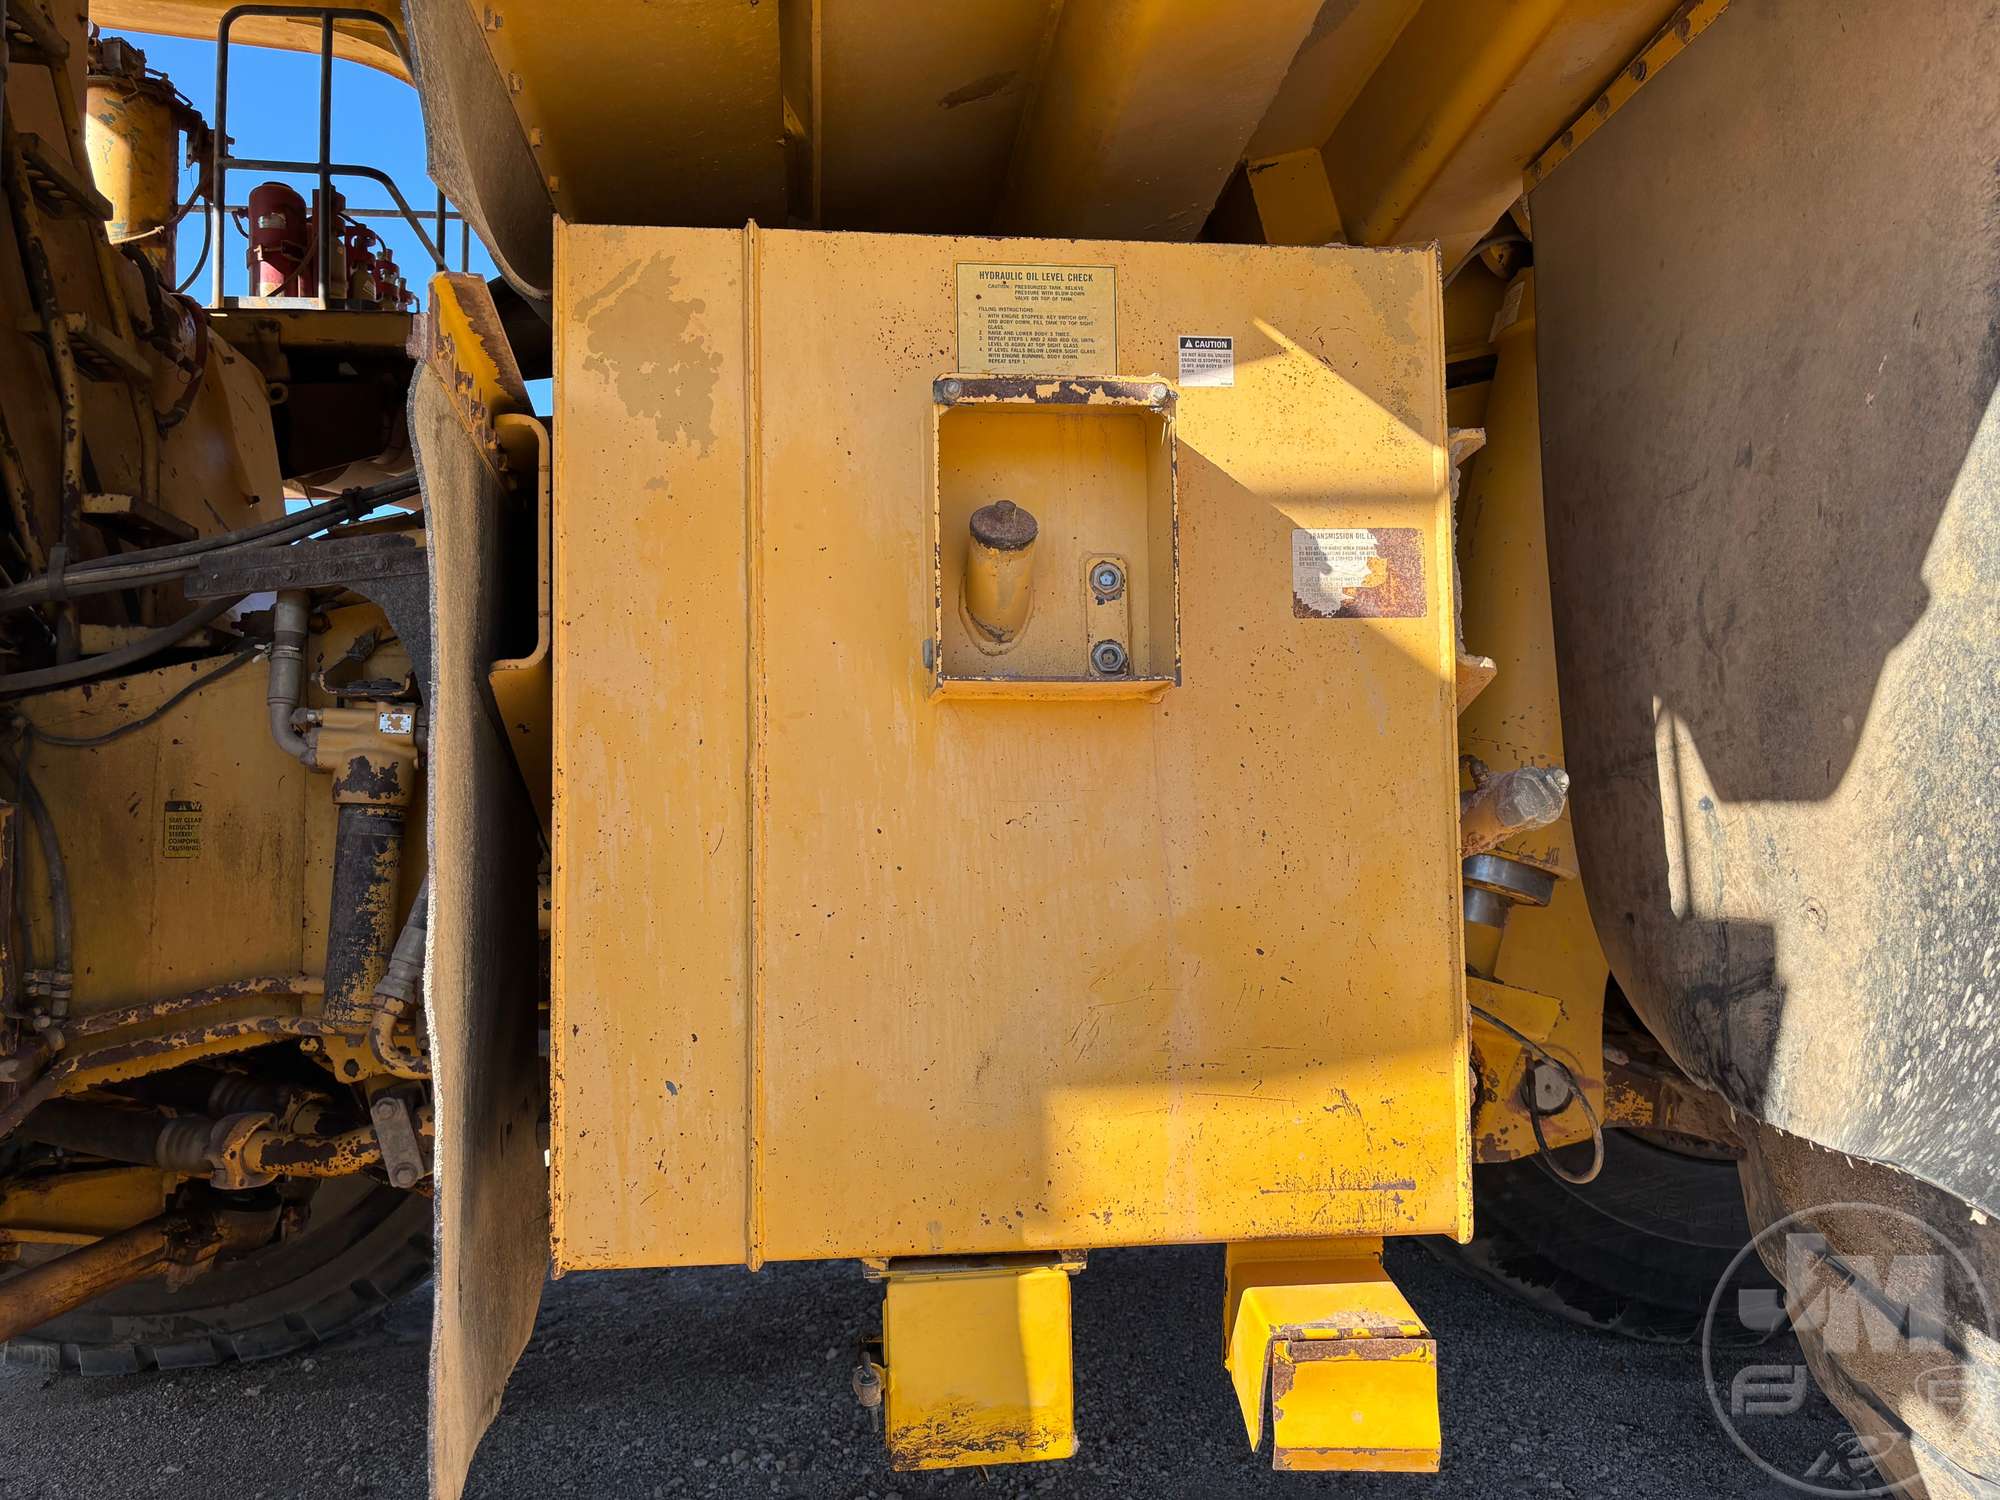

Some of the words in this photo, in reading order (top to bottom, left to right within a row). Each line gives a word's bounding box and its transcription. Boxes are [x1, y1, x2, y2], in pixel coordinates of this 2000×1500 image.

[980, 271, 1023, 281] HYDRAULIC
[1027, 272, 1040, 281] OIL
[1042, 272, 1064, 281] LEVEL
[1068, 273, 1093, 282] CHECK
